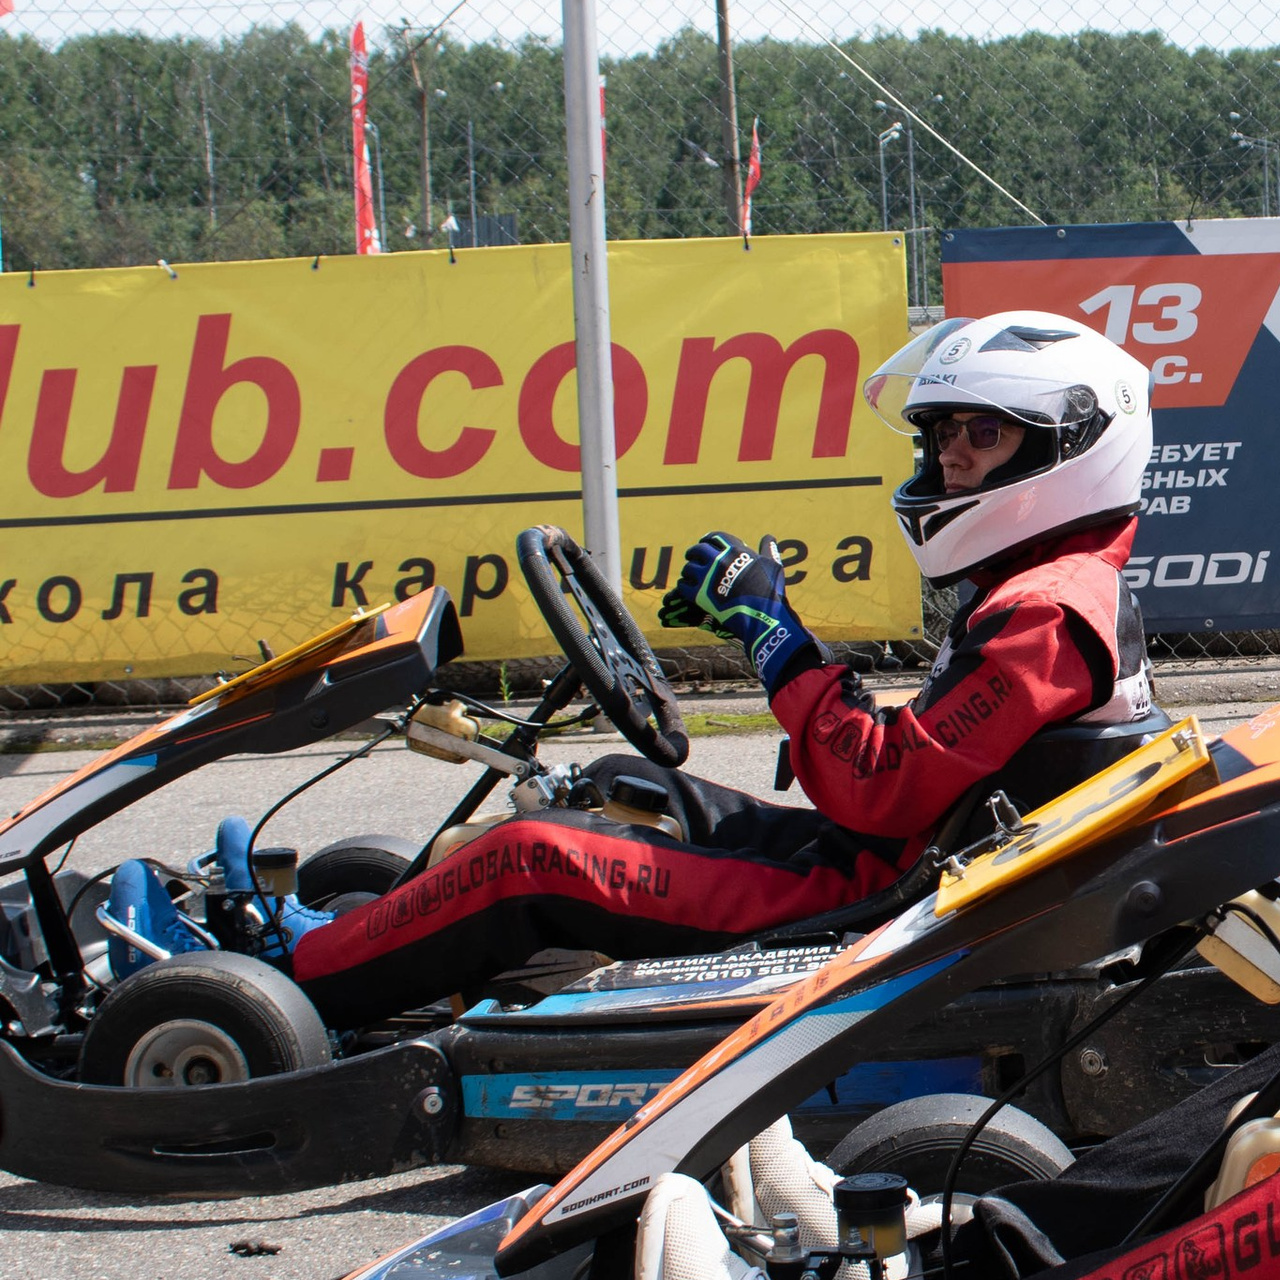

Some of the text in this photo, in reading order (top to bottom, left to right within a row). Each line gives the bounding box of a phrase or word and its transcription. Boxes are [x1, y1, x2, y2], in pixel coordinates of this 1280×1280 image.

[1079, 283, 1203, 345] 13
[717, 552, 754, 596] sparco
[441, 842, 671, 902] GLOBALRACING.RU
[635, 955, 722, 970] КАРТИНГ
[728, 946, 831, 962] АКАДЕМИЯ
[561, 1176, 651, 1214] SODIKART.COM
